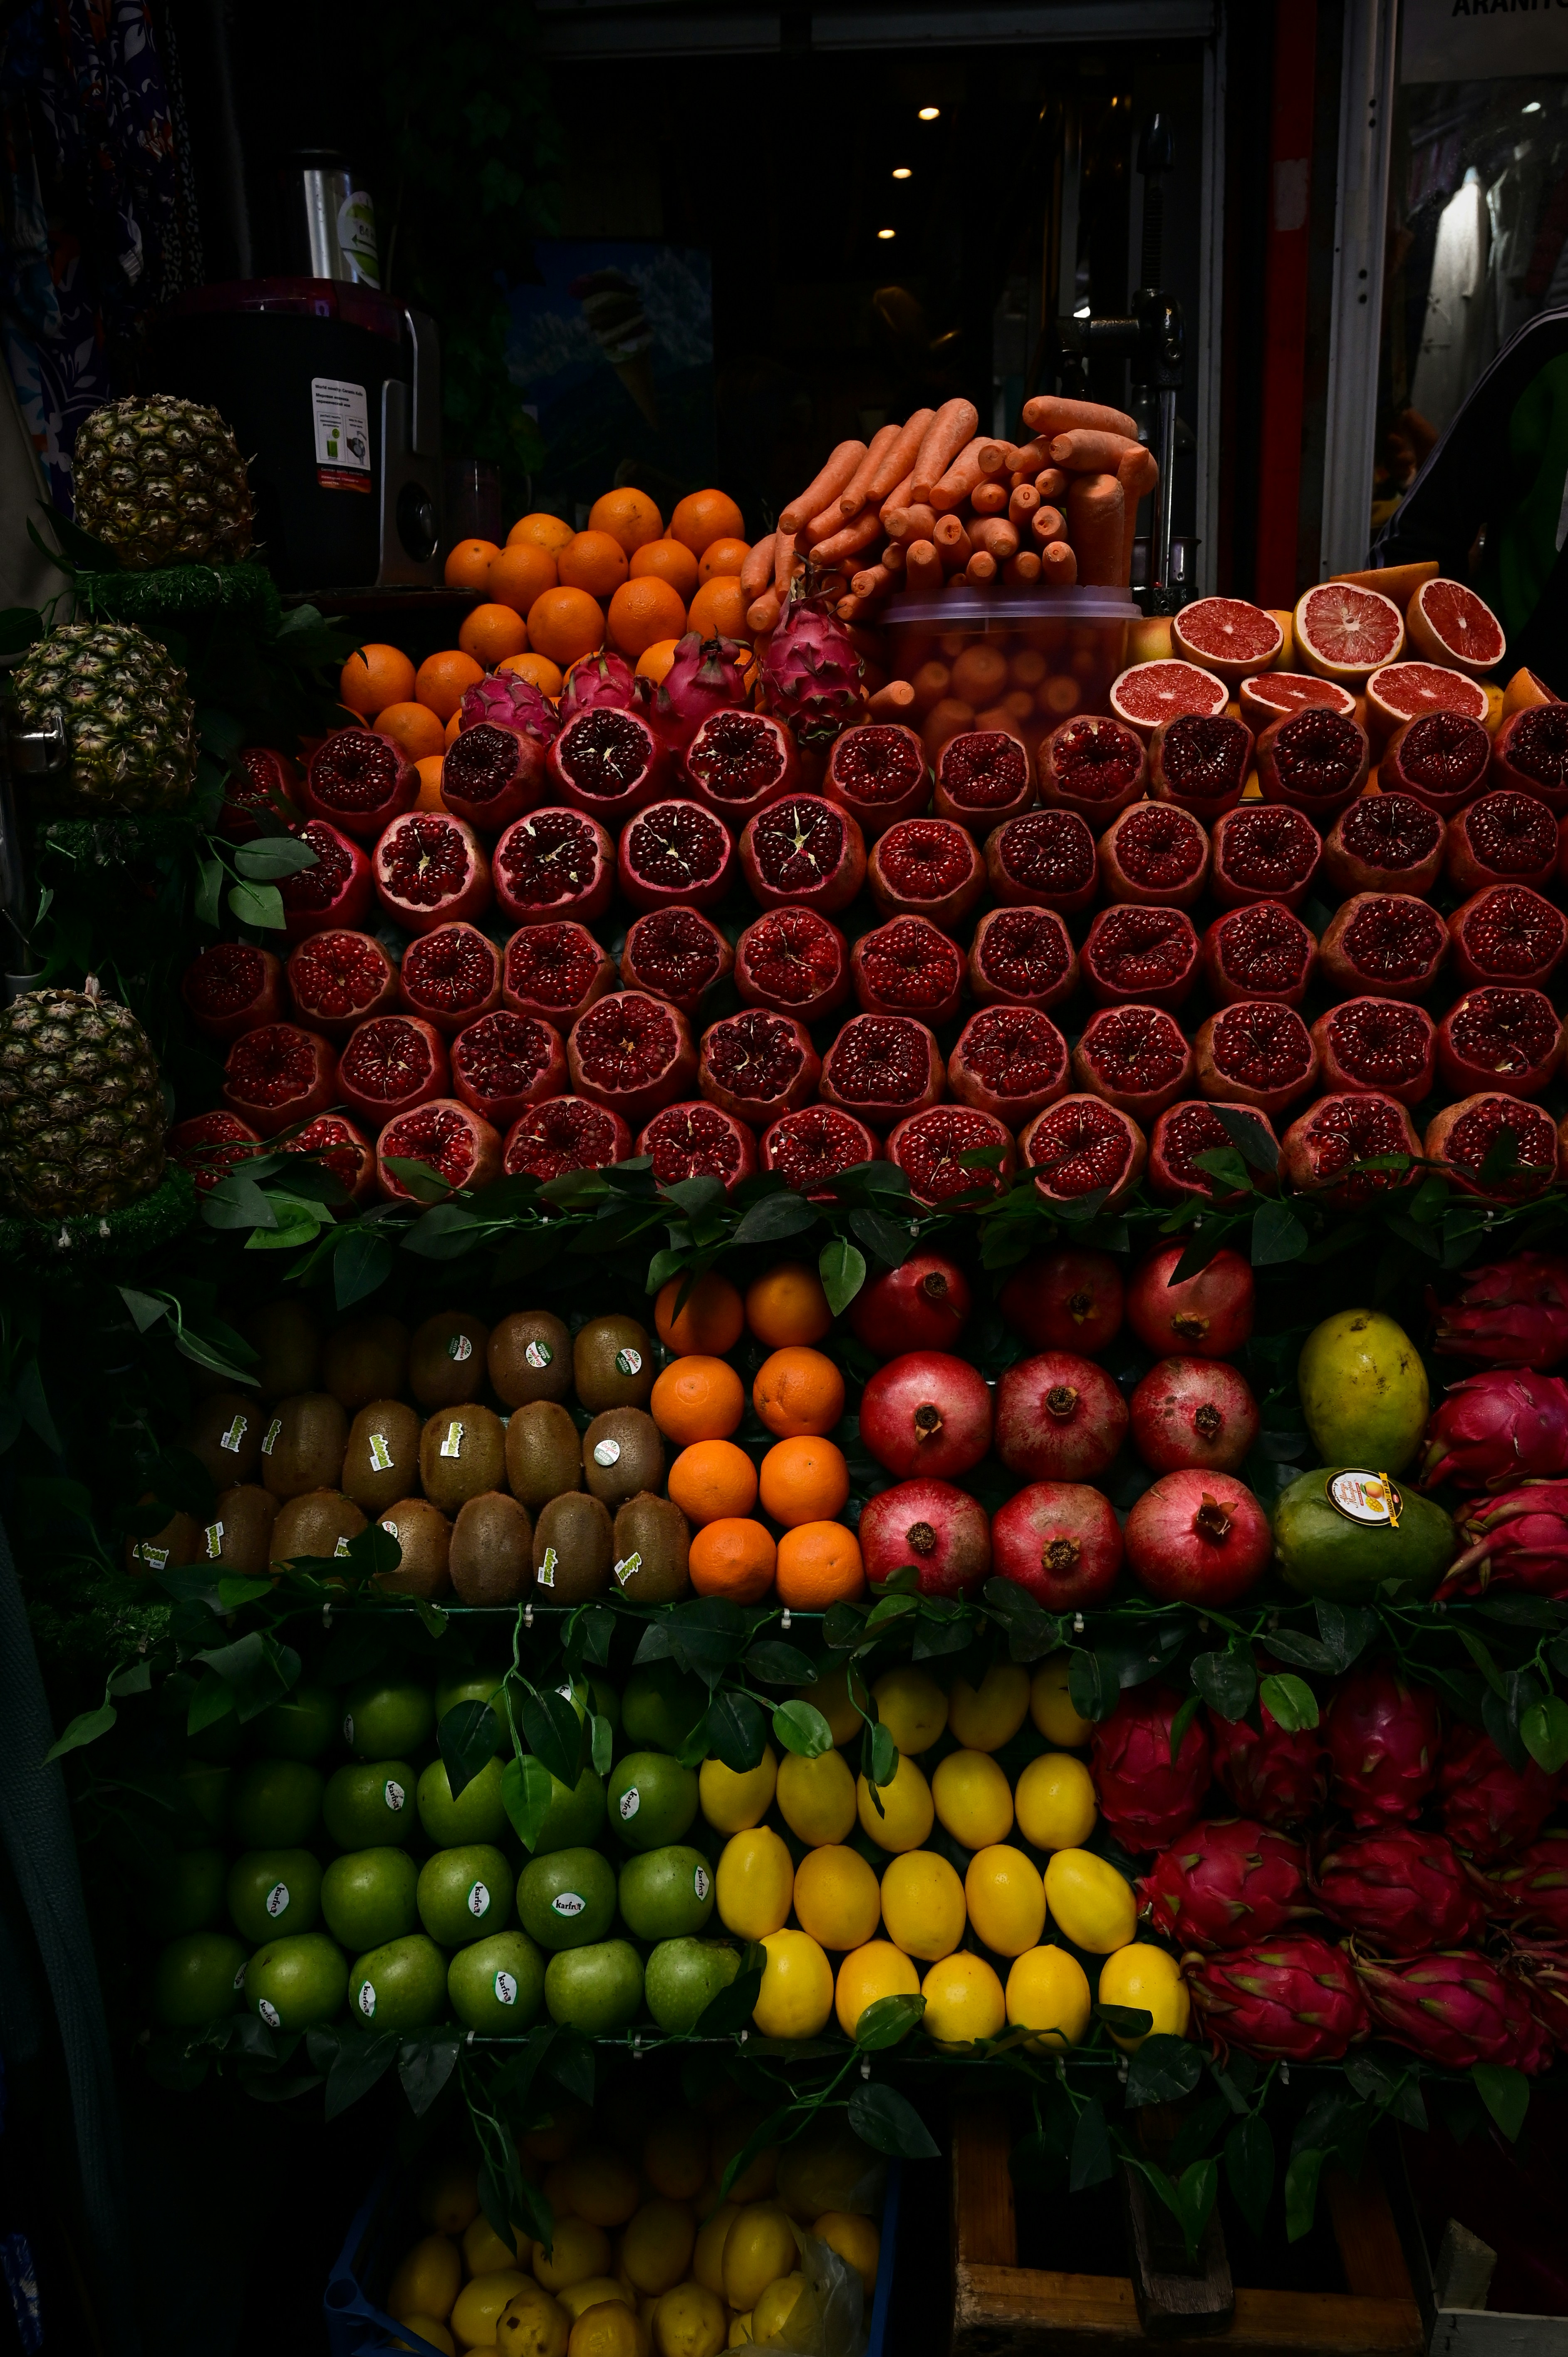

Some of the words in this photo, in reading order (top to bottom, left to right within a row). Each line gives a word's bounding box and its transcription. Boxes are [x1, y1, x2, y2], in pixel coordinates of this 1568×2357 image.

[537, 1345, 546, 1359] GREEN
[620, 1357, 630, 1370] GREEN
[599, 1451, 611, 1460] GREEN
[1387, 1499, 1395, 1517] MANGO
